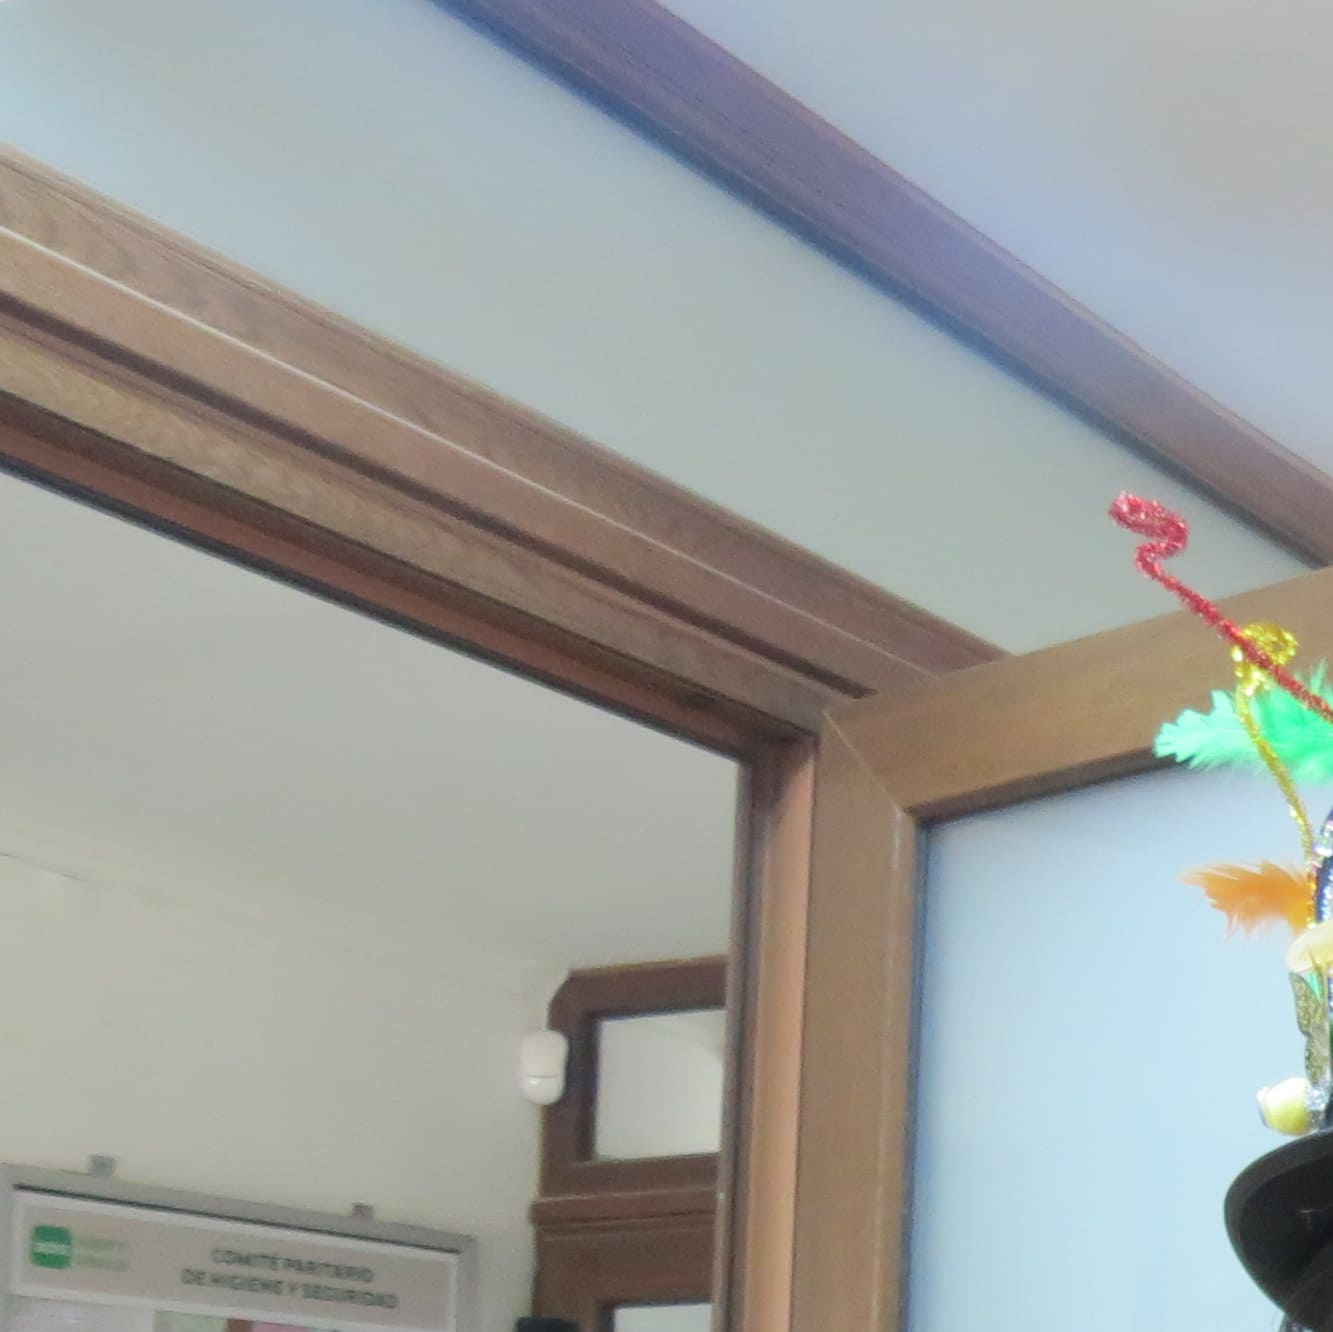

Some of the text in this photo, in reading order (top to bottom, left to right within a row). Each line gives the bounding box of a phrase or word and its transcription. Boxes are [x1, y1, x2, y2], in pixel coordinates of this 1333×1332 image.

[180, 1267, 207, 1287] DE
[209, 1271, 283, 1296] HIGIENE
[301, 1282, 399, 1309] SEGURIDAD
